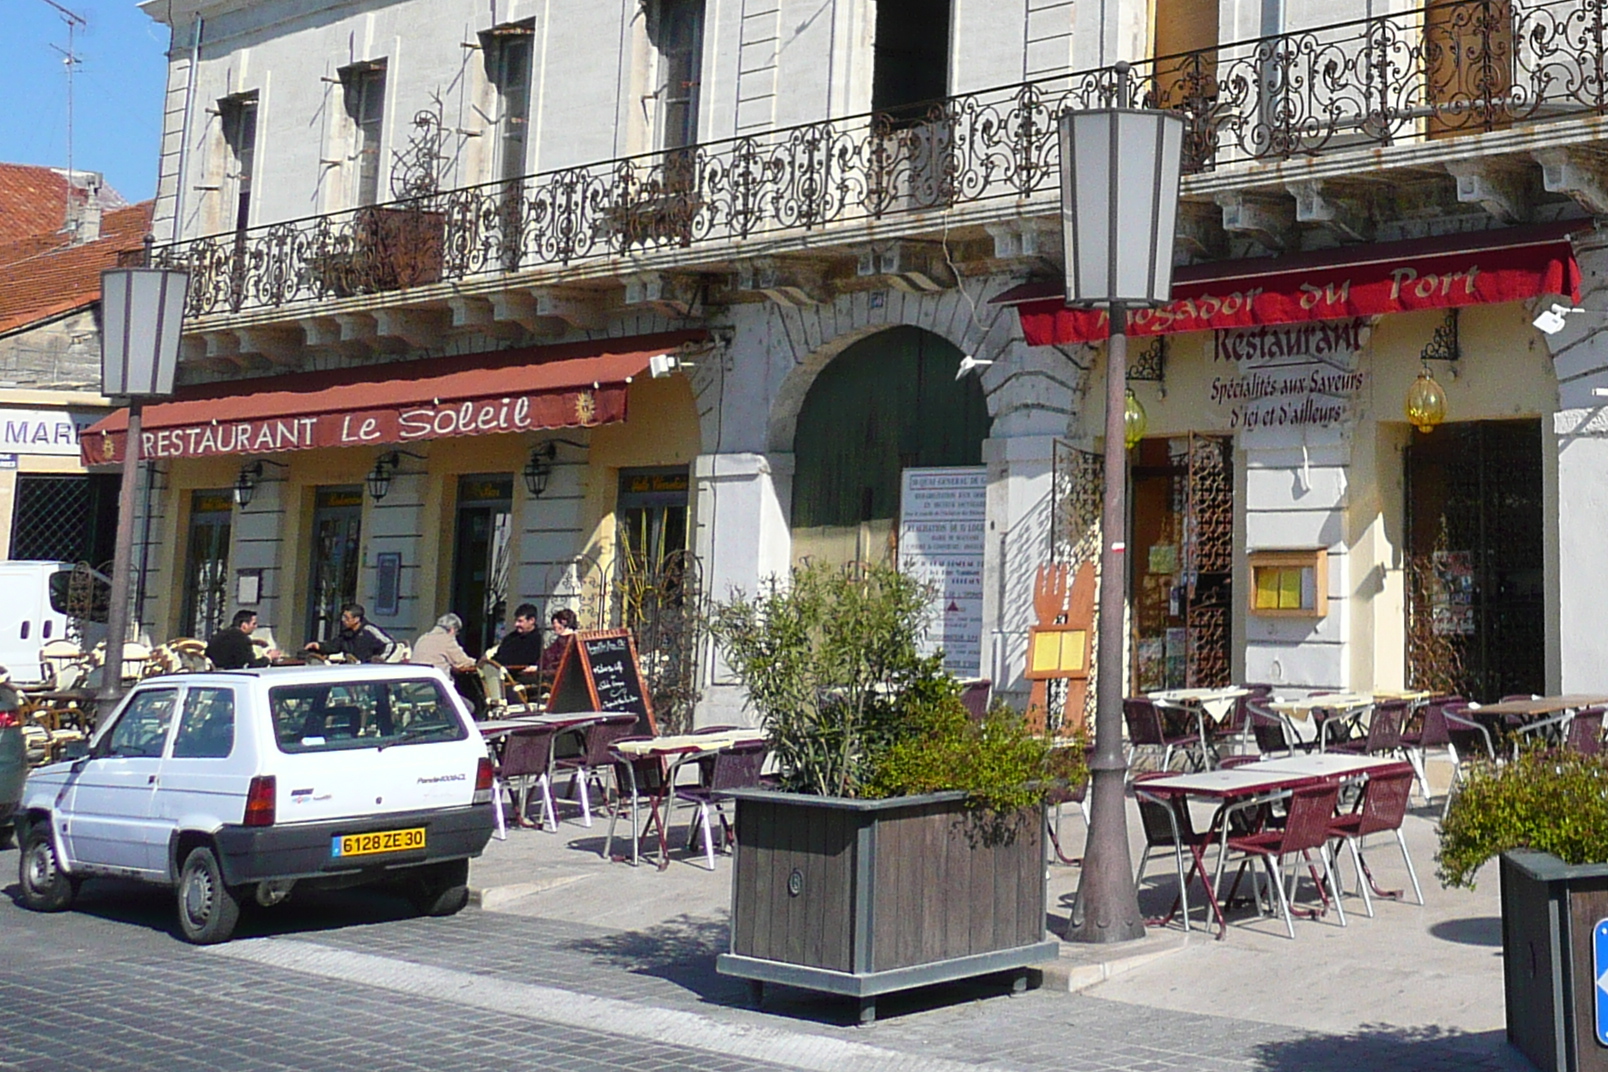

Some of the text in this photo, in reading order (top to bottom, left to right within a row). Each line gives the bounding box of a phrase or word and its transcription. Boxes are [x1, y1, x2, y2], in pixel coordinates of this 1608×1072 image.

[1300, 279, 1350, 310] du
[1390, 264, 1482, 301] Port
[1213, 316, 1366, 363] Restaurant
[1210, 369, 1364, 405] Spécialités aux Saveurs
[341, 396, 532, 442] Le Soleil
[1262, 406, 1276, 426] et
[1278, 395, 1342, 426] d'ailleurs
[5, 420, 92, 445] MARI
[142, 418, 318, 457] RESTAURANT
[343, 830, 423, 853] 6128 ZE 30
